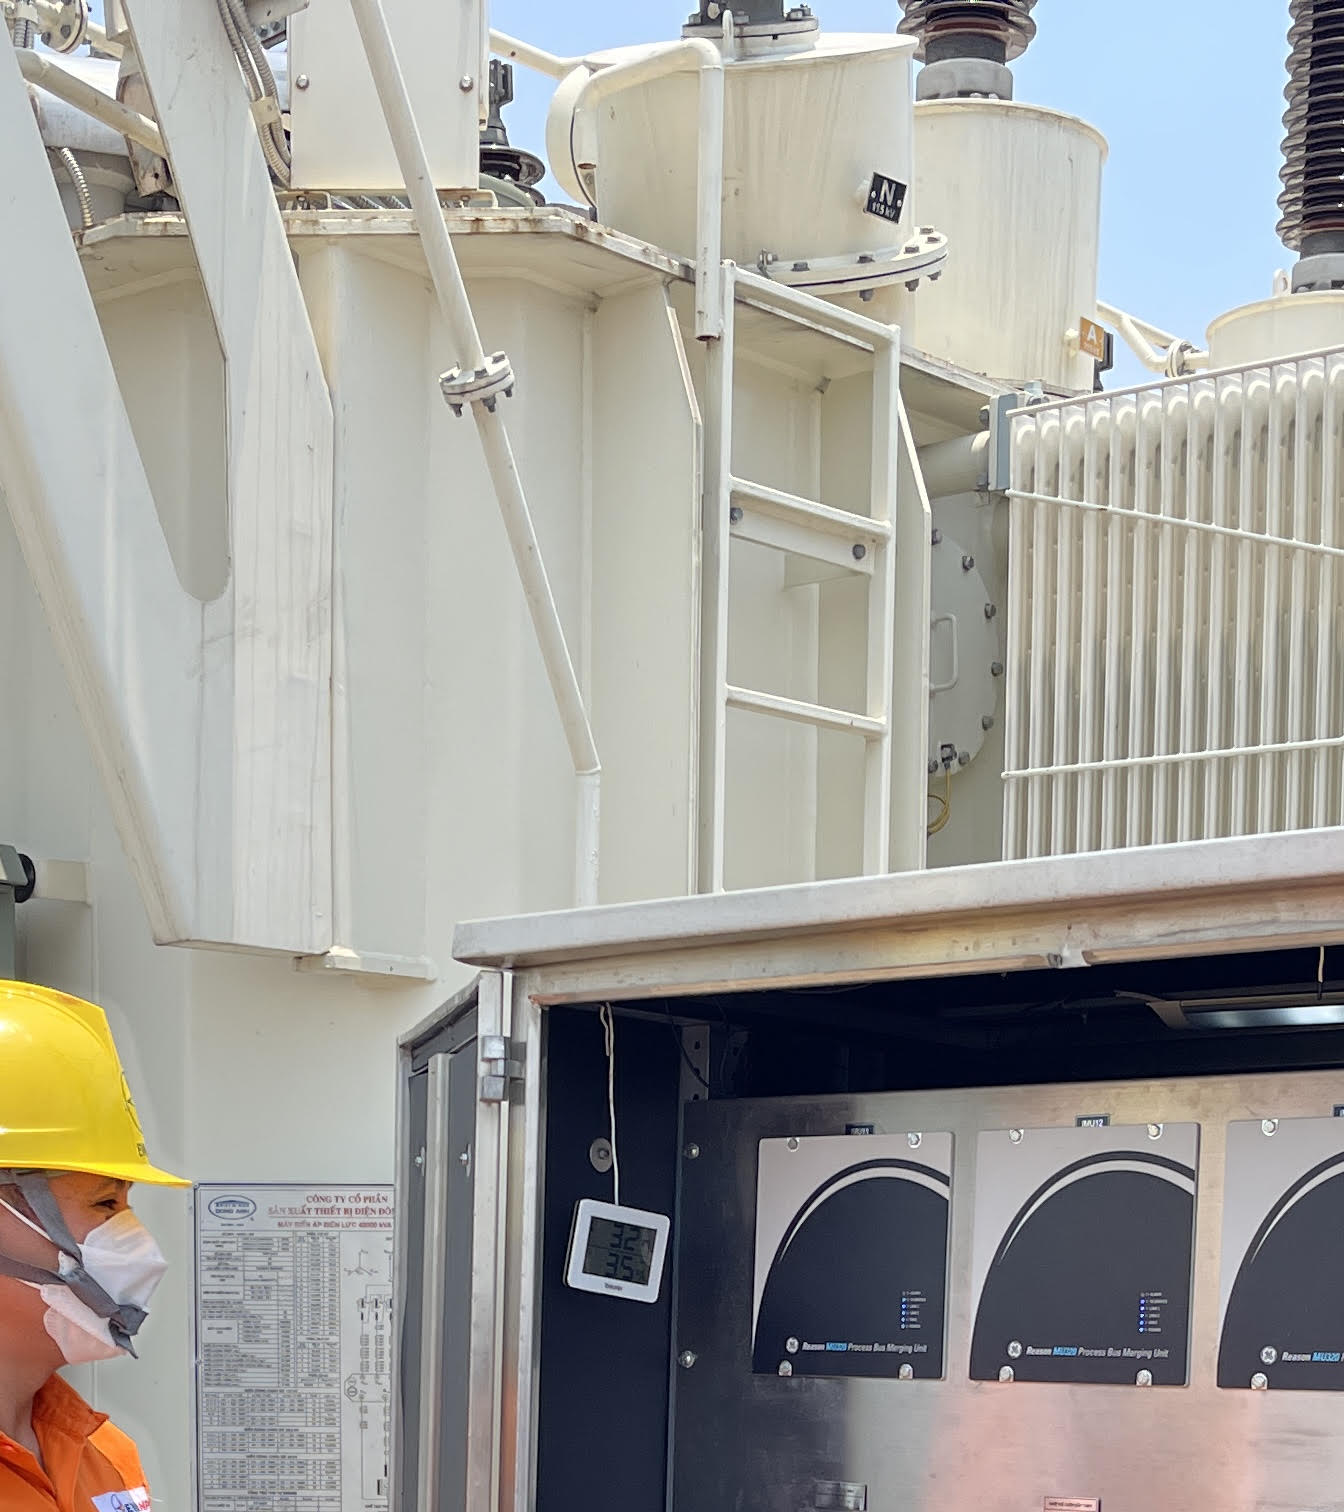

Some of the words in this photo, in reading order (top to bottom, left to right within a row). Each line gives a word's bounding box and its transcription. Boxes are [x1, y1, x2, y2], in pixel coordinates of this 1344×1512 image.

[879, 179, 897, 206] N
[1087, 324, 1097, 345] A
[306, 1193, 332, 1204] CÔNG
[334, 1196, 346, 1204] TY
[1026, 1346, 1052, 1356] Reason
[1053, 1347, 1077, 1356] MU320
[1078, 1347, 1106, 1357] Process
[1107, 1348, 1121, 1357] Bus
[1122, 1348, 1152, 1359] Merging
[1154, 1349, 1169, 1358] Unit
[1282, 1352, 1311, 1362] Reason
[1312, 1352, 1341, 1362] MU320
